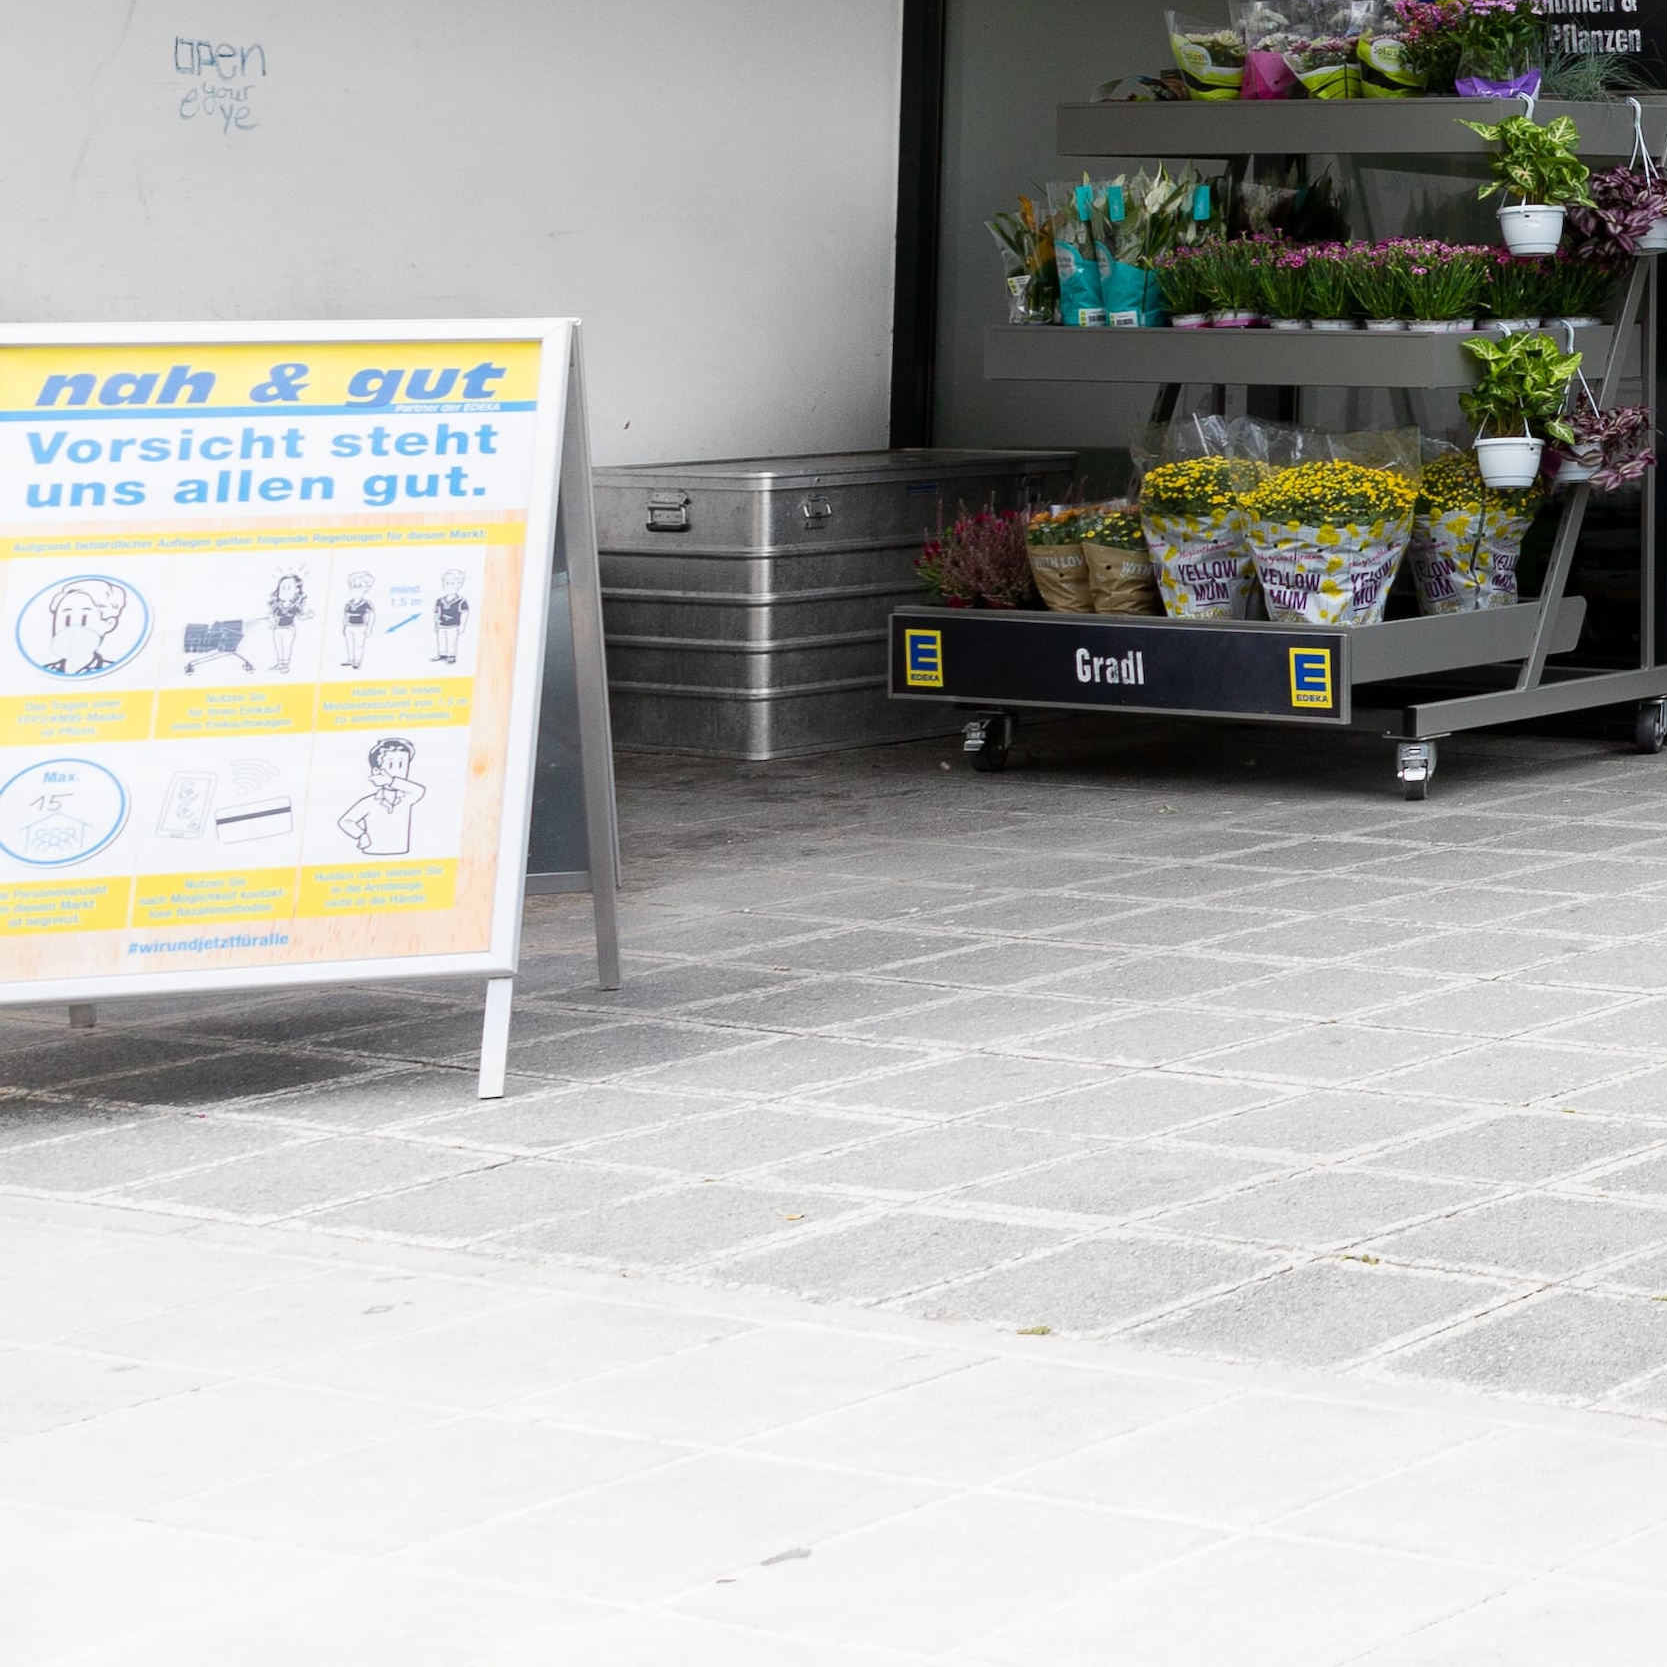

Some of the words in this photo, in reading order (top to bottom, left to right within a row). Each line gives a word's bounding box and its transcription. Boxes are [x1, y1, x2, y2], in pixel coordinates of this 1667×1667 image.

[1547, 24, 1642, 54] Pflanzen
[1374, 44, 1401, 58] Splas
[35, 365, 216, 406] nah
[250, 363, 310, 403] &
[345, 362, 507, 409] gut
[395, 404, 438, 413] Partner
[441, 403, 461, 412] der
[464, 402, 500, 412] EDEKA
[27, 427, 305, 464] Vorsicht
[331, 423, 498, 458] steht
[26, 481, 146, 508] uns
[174, 470, 335, 504] allen
[363, 466, 486, 506] gut.
[13, 540, 71, 552] Aufgrund
[158, 536, 211, 549] Auflagen
[1060, 555, 1083, 568] LOV
[1178, 558, 1238, 585] YELLOW
[1260, 565, 1321, 593] YELLOW
[391, 584, 423, 594] mind.
[1194, 582, 1230, 601] MUM
[410, 598, 422, 606] m
[1269, 588, 1308, 610] MUM
[1075, 647, 1145, 686] Gradl
[911, 673, 940, 683] EDEKA
[1296, 693, 1328, 704] EDEKA
[43, 771, 80, 782] Max.
[29, 793, 74, 812] 15
[128, 933, 289, 954] #wirundjetztfüralle
